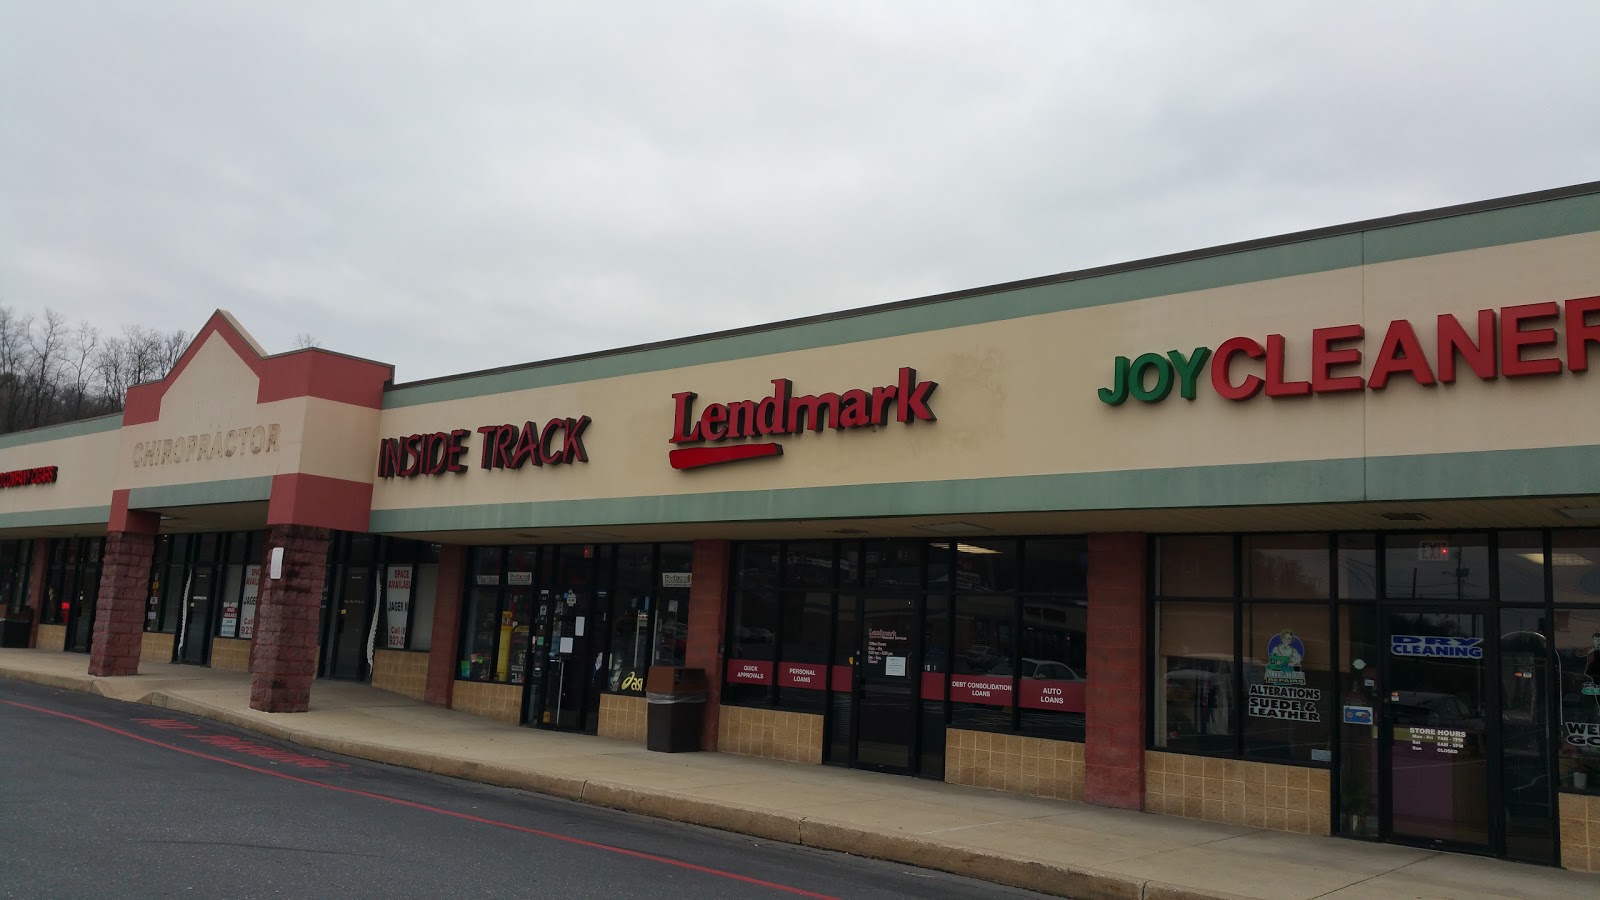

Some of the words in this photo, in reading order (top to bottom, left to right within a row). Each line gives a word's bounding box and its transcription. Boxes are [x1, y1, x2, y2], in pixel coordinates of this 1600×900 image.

[1097, 346, 1213, 406] JOY
[668, 366, 939, 445] Lendmark
[132, 423, 281, 468] CHIROPRACTOR
[377, 428, 472, 478] INSIDE
[477, 415, 592, 470] TRACK
[394, 569, 410, 579] SPACE
[1391, 634, 1484, 647] DRY
[1391, 644, 1483, 659] CLEANING
[743, 664, 759, 672] QUICK
[789, 667, 816, 676] PERSONAL
[736, 671, 764, 680] APPROVALS
[793, 675, 811, 683] LOANS
[951, 680, 967, 688] DEBT
[967, 681, 1012, 692] CONSOLIDATION
[1042, 687, 1062, 696] AUTO
[1249, 684, 1321, 700] ALTERATIONS
[971, 689, 991, 698] LOANS
[1040, 695, 1064, 705] LOANS
[1249, 697, 1301, 711] SUEDE
[1304, 701, 1316, 713] &
[1249, 707, 1321, 721] LEATHER
[1409, 727, 1436, 736] STORE
[1437, 729, 1467, 738] HOURS
